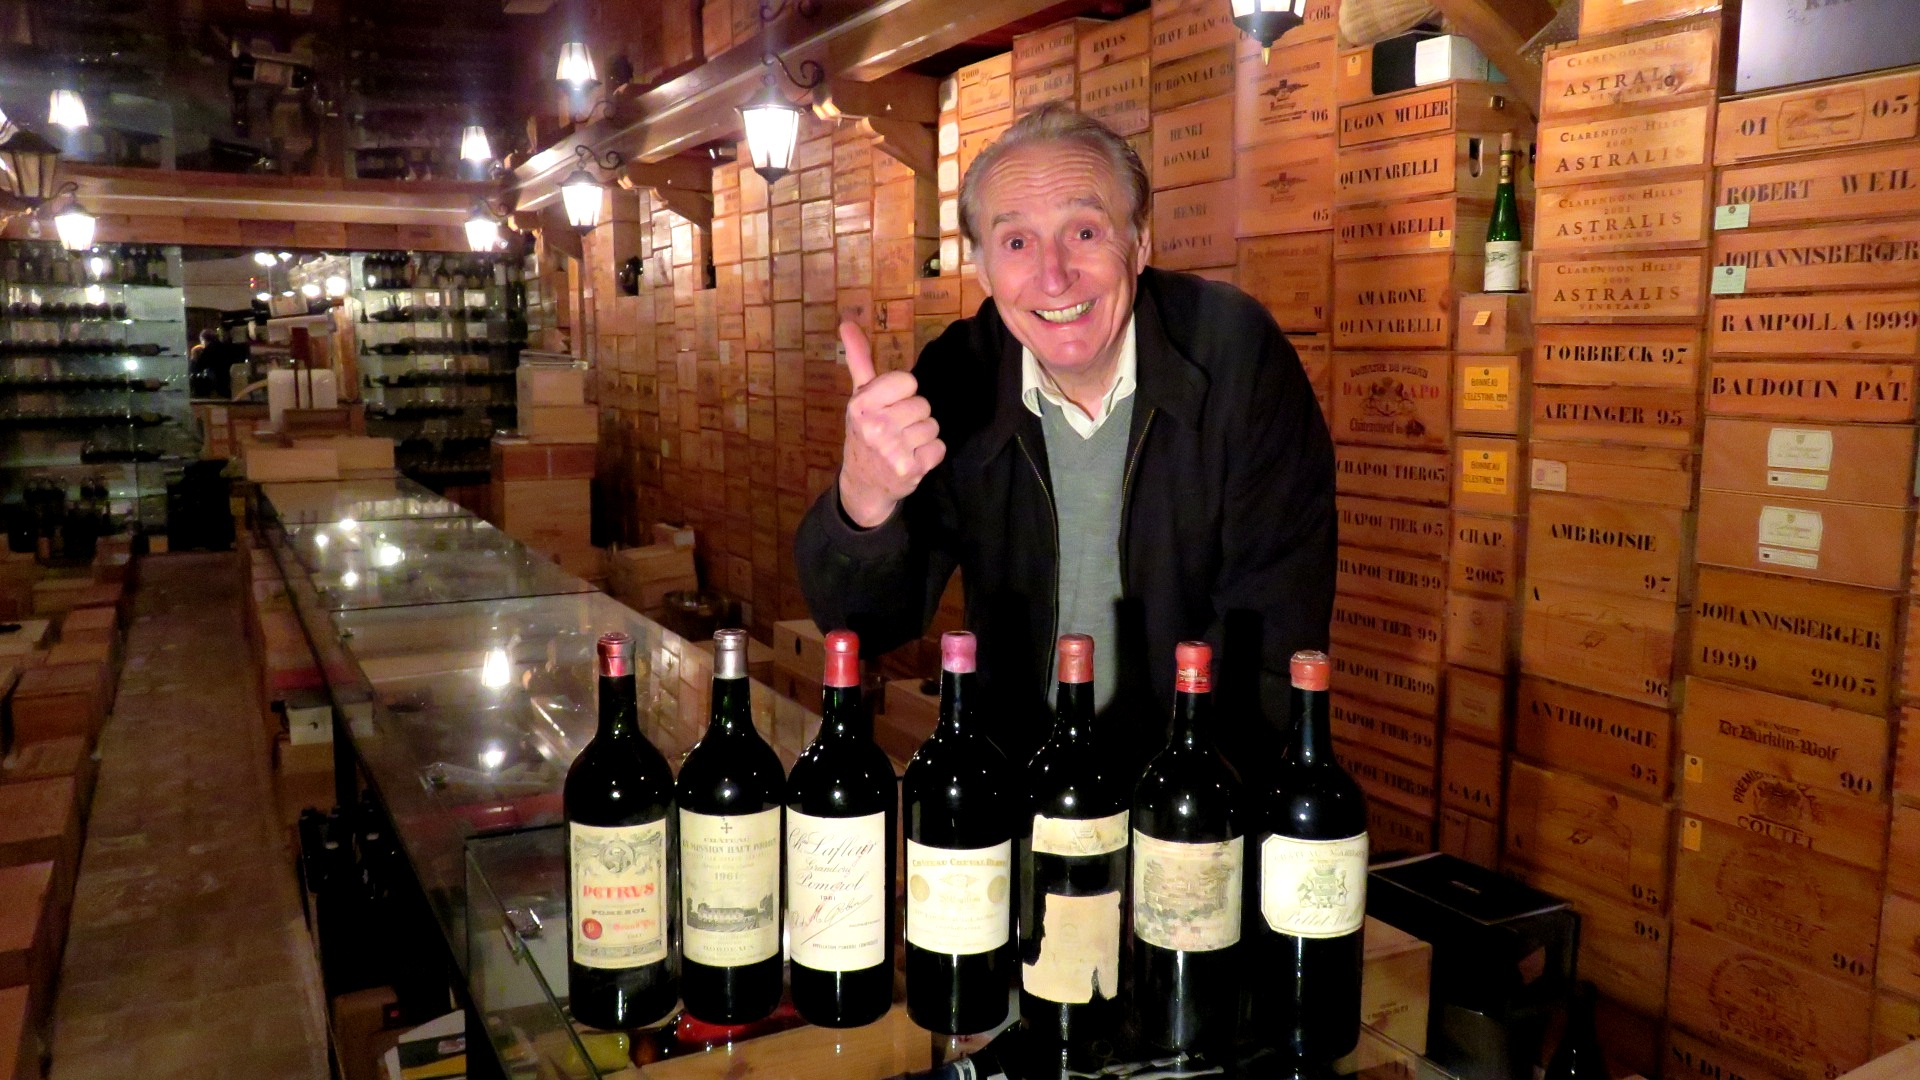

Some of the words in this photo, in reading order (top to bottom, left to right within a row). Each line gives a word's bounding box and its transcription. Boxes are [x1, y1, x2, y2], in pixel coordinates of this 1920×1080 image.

[1311, 109, 1329, 122] 06
[1344, 111, 1384, 133] EGON
[1396, 101, 1449, 123] MULLER
[1872, 94, 1909, 118] 05
[1560, 125, 1638, 143] CLARENDON
[1740, 116, 1768, 136] 01
[1555, 146, 1687, 172] ASTRALIS
[1340, 158, 1439, 189] QUINTARELLI
[1726, 179, 1814, 205] ROBERT
[1841, 169, 1917, 195] WEIL
[1558, 192, 1634, 209] CLARENDON
[1643, 188, 1683, 200] HILLS
[1313, 209, 1329, 222] 05
[1556, 212, 1682, 237] ASTRALIS
[1341, 216, 1445, 243] QUINTARELLI
[1557, 265, 1633, 275] CLARENDON
[1641, 261, 1681, 272] HILLS
[1357, 289, 1426, 305] AMARONE
[1554, 286, 1680, 302] ASTRALIS
[1579, 302, 1652, 310] VINEYARD
[1340, 318, 1442, 336] QUINTARELLI
[1721, 312, 1855, 332] RAMPOLLA
[1865, 310, 1918, 330] 1999
[1544, 344, 1653, 363] TORBRECK
[1662, 348, 1688, 364] 97
[1712, 377, 1839, 398] BAUDOUIN
[1855, 381, 1909, 402] PAT.
[1543, 403, 1644, 424] ARTINGER
[1657, 409, 1683, 426] 95
[1428, 468, 1446, 482] 05
[1340, 510, 1418, 535] HAPOUTIER
[1423, 525, 1443, 537] 05
[1459, 528, 1505, 548] CHAP.
[1551, 523, 1657, 552] AMBROISIE
[1338, 560, 1418, 587] HAPOUTIER
[1421, 576, 1441, 589] 99
[1644, 574, 1671, 592] 97
[1335, 609, 1412, 638] HAPOUTIER
[1417, 628, 1437, 642] 99
[1702, 646, 1757, 671] 1999
[1811, 668, 1877, 697] 2005
[1417, 681, 1435, 696] 99
[1644, 679, 1669, 698] 96
[1530, 699, 1658, 749] ANTHOLOGIE
[1630, 762, 1658, 785] 95
[1840, 771, 1872, 793] 90
[796, 870, 869, 891] Pomerol
[1634, 920, 1660, 942] 99
[1832, 952, 1865, 977] 90
